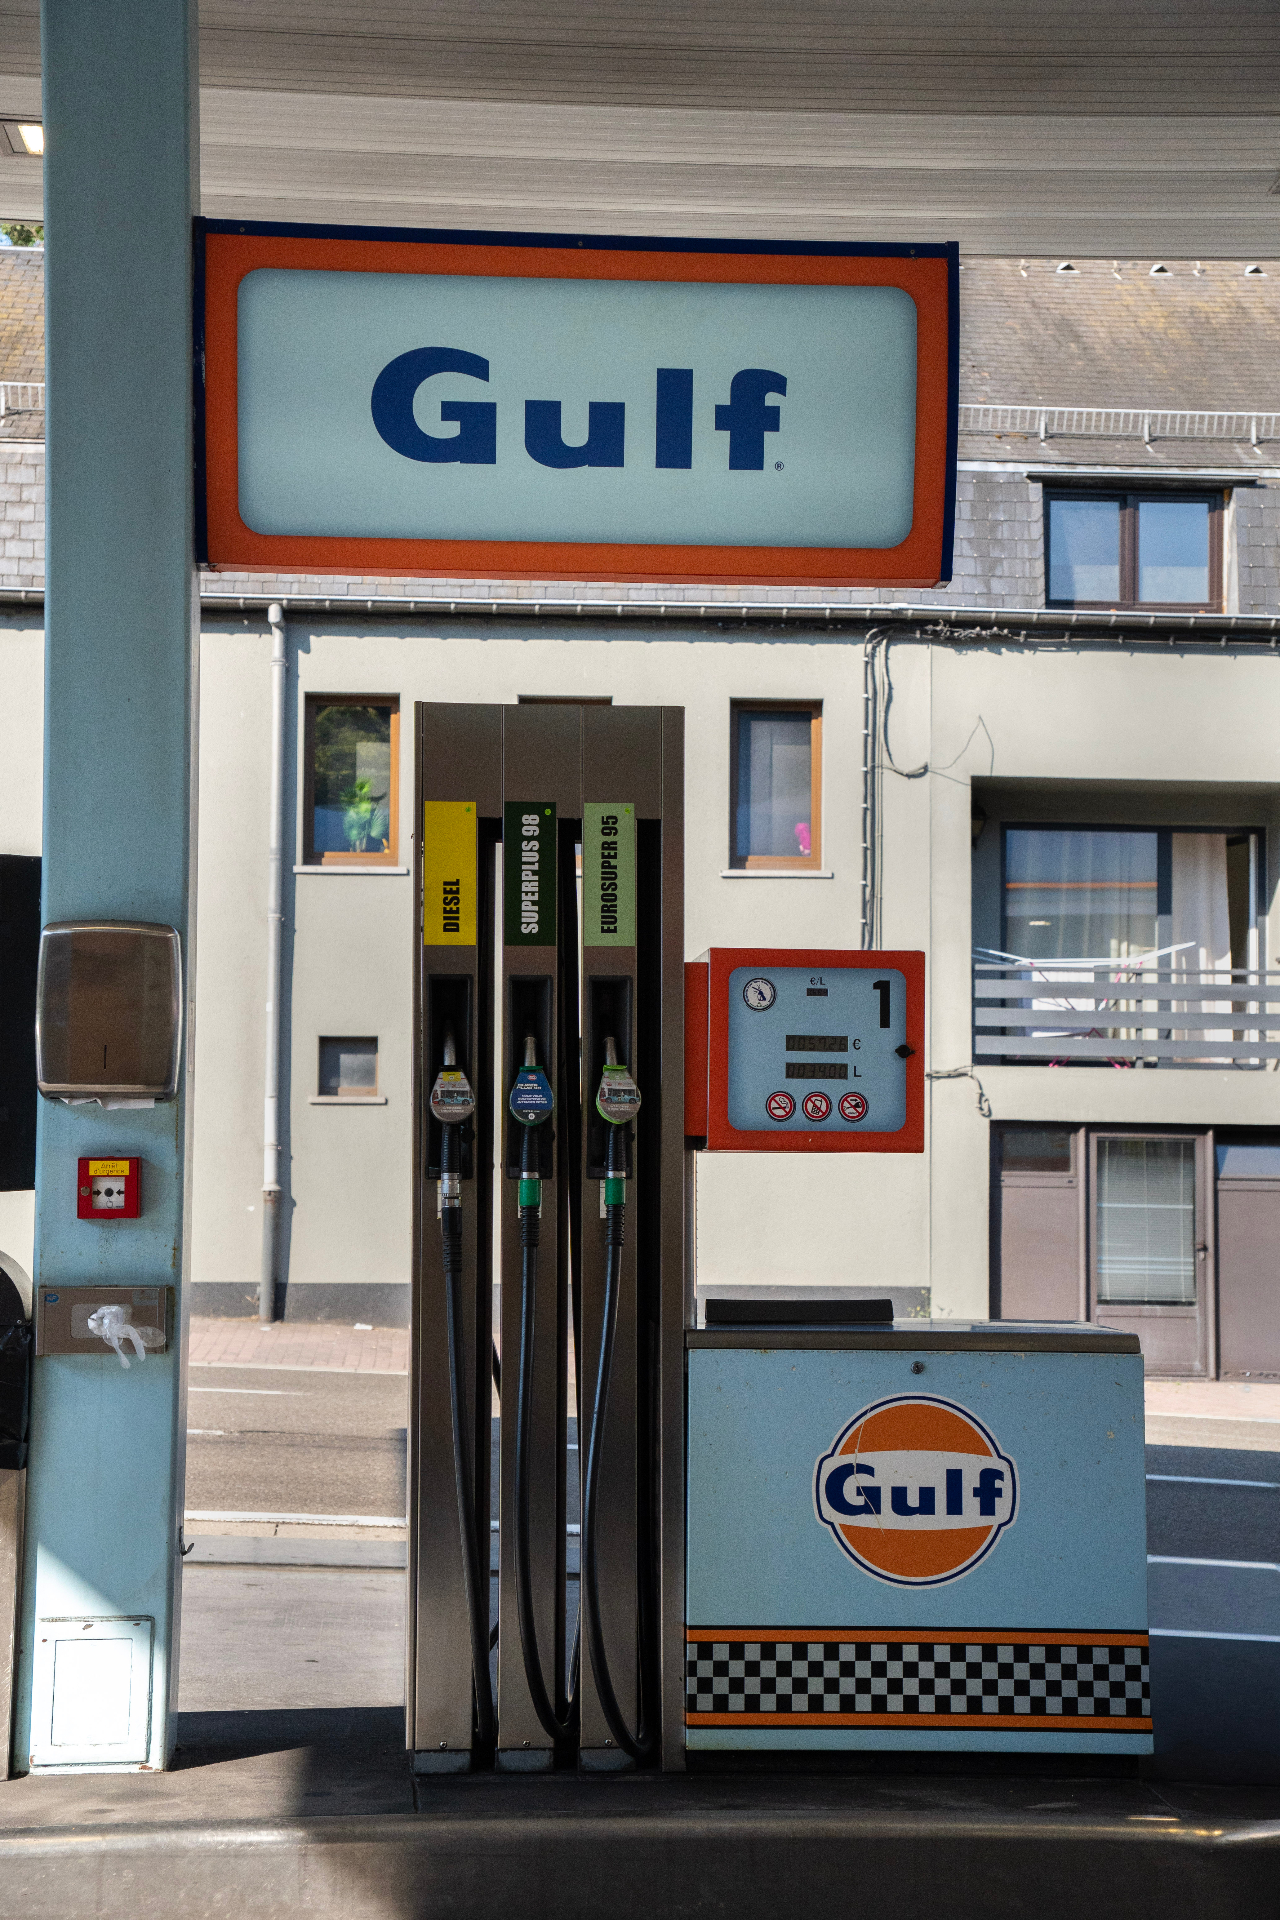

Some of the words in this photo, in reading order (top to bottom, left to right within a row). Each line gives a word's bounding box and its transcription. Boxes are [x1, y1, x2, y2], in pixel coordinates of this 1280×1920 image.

[371, 346, 788, 471] Gulf
[521, 814, 540, 836] 98
[601, 815, 619, 837] 95
[443, 878, 460, 933] DIESEL
[521, 840, 540, 934] SUPERPLUS
[601, 841, 618, 934] EUROSUPER
[810, 976, 825, 986] €/L
[873, 980, 890, 1028] 1
[852, 1039, 861, 1050] €
[853, 1066, 862, 1077] L
[825, 1463, 1004, 1516] Gulf
